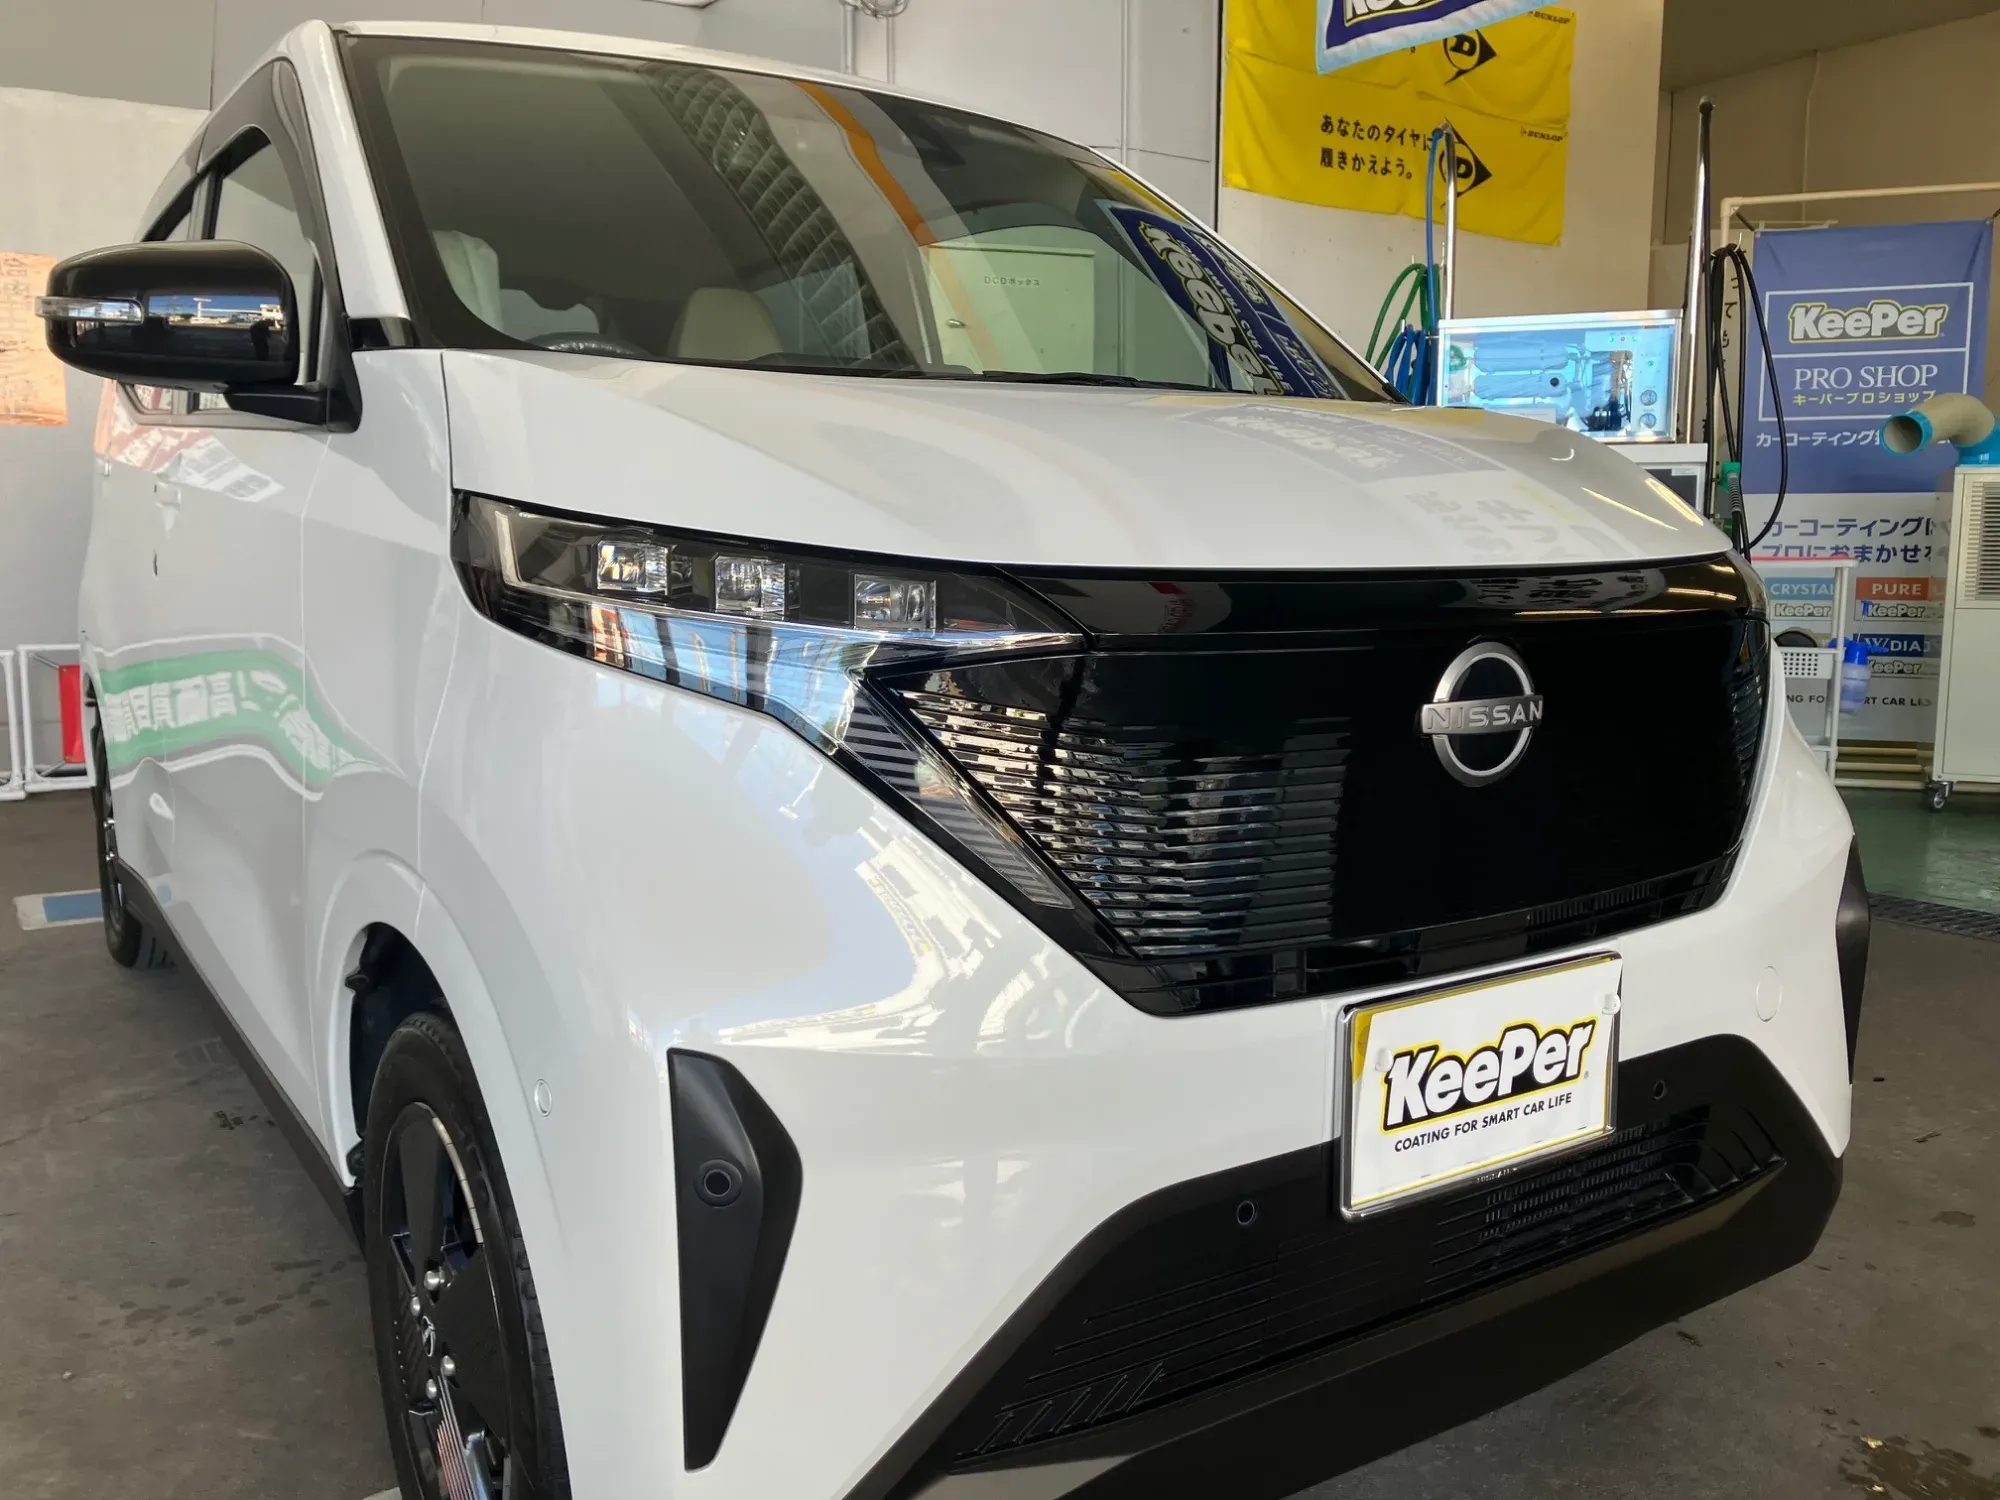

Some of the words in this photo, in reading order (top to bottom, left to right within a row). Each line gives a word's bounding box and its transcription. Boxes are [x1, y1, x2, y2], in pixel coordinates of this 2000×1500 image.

[1790, 301, 1947, 342] KeePer
[1793, 366, 1852, 390] PRO
[1859, 364, 1938, 388] SHOP
[1872, 583, 1921, 596] PURE
[1775, 603, 1831, 617] KeePer
[1868, 603, 1925, 618] KeePer
[1882, 696, 1905, 706] CAR
[1427, 700, 1542, 730] NISSAN
[1383, 1019, 1597, 1131] KeePer
[1394, 1127, 1450, 1153] COATING
[1454, 1119, 1478, 1136] FOR
[1482, 1107, 1520, 1128] SMART
[1523, 1100, 1545, 1116] CAR
[1548, 1092, 1572, 1109] LIFE
